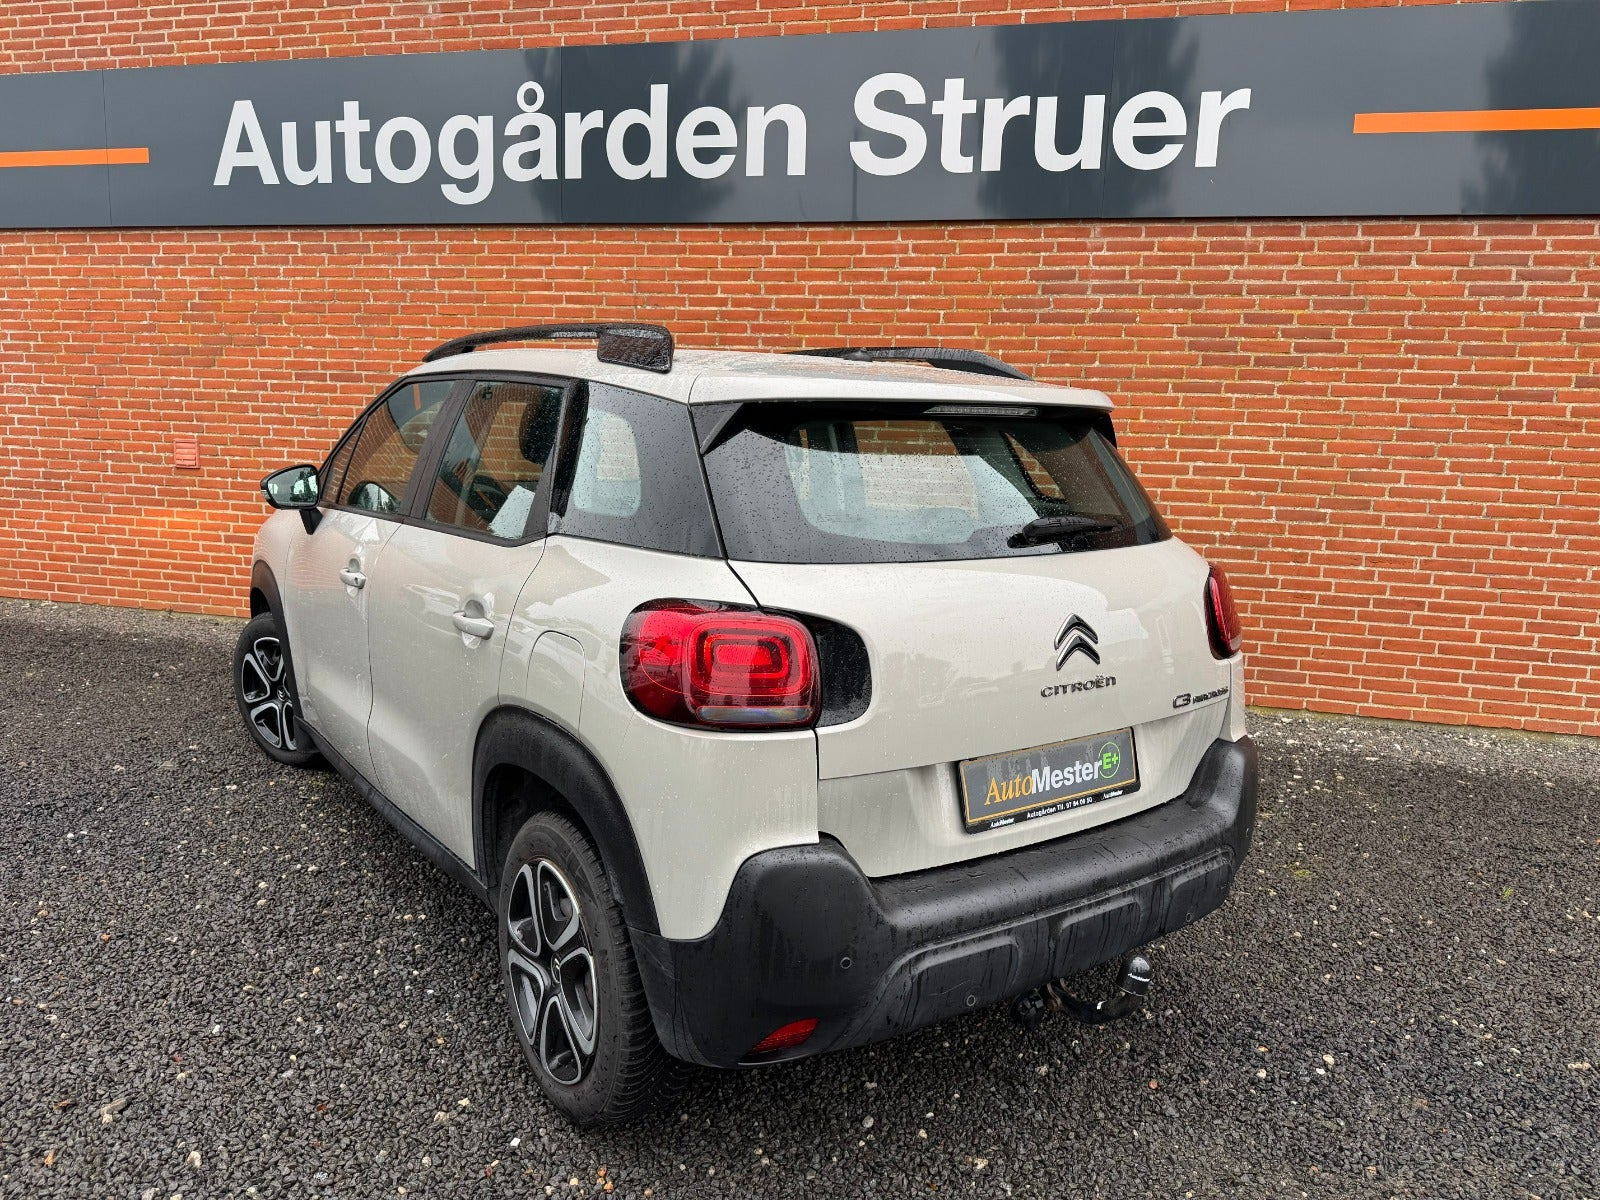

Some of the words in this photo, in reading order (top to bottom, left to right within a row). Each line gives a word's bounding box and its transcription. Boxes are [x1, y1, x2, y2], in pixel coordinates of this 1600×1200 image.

[213, 81, 807, 205] Autogården
[849, 72, 1251, 176] Struer
[1172, 693, 1191, 708] C3
[984, 759, 1102, 805] AutoMester
